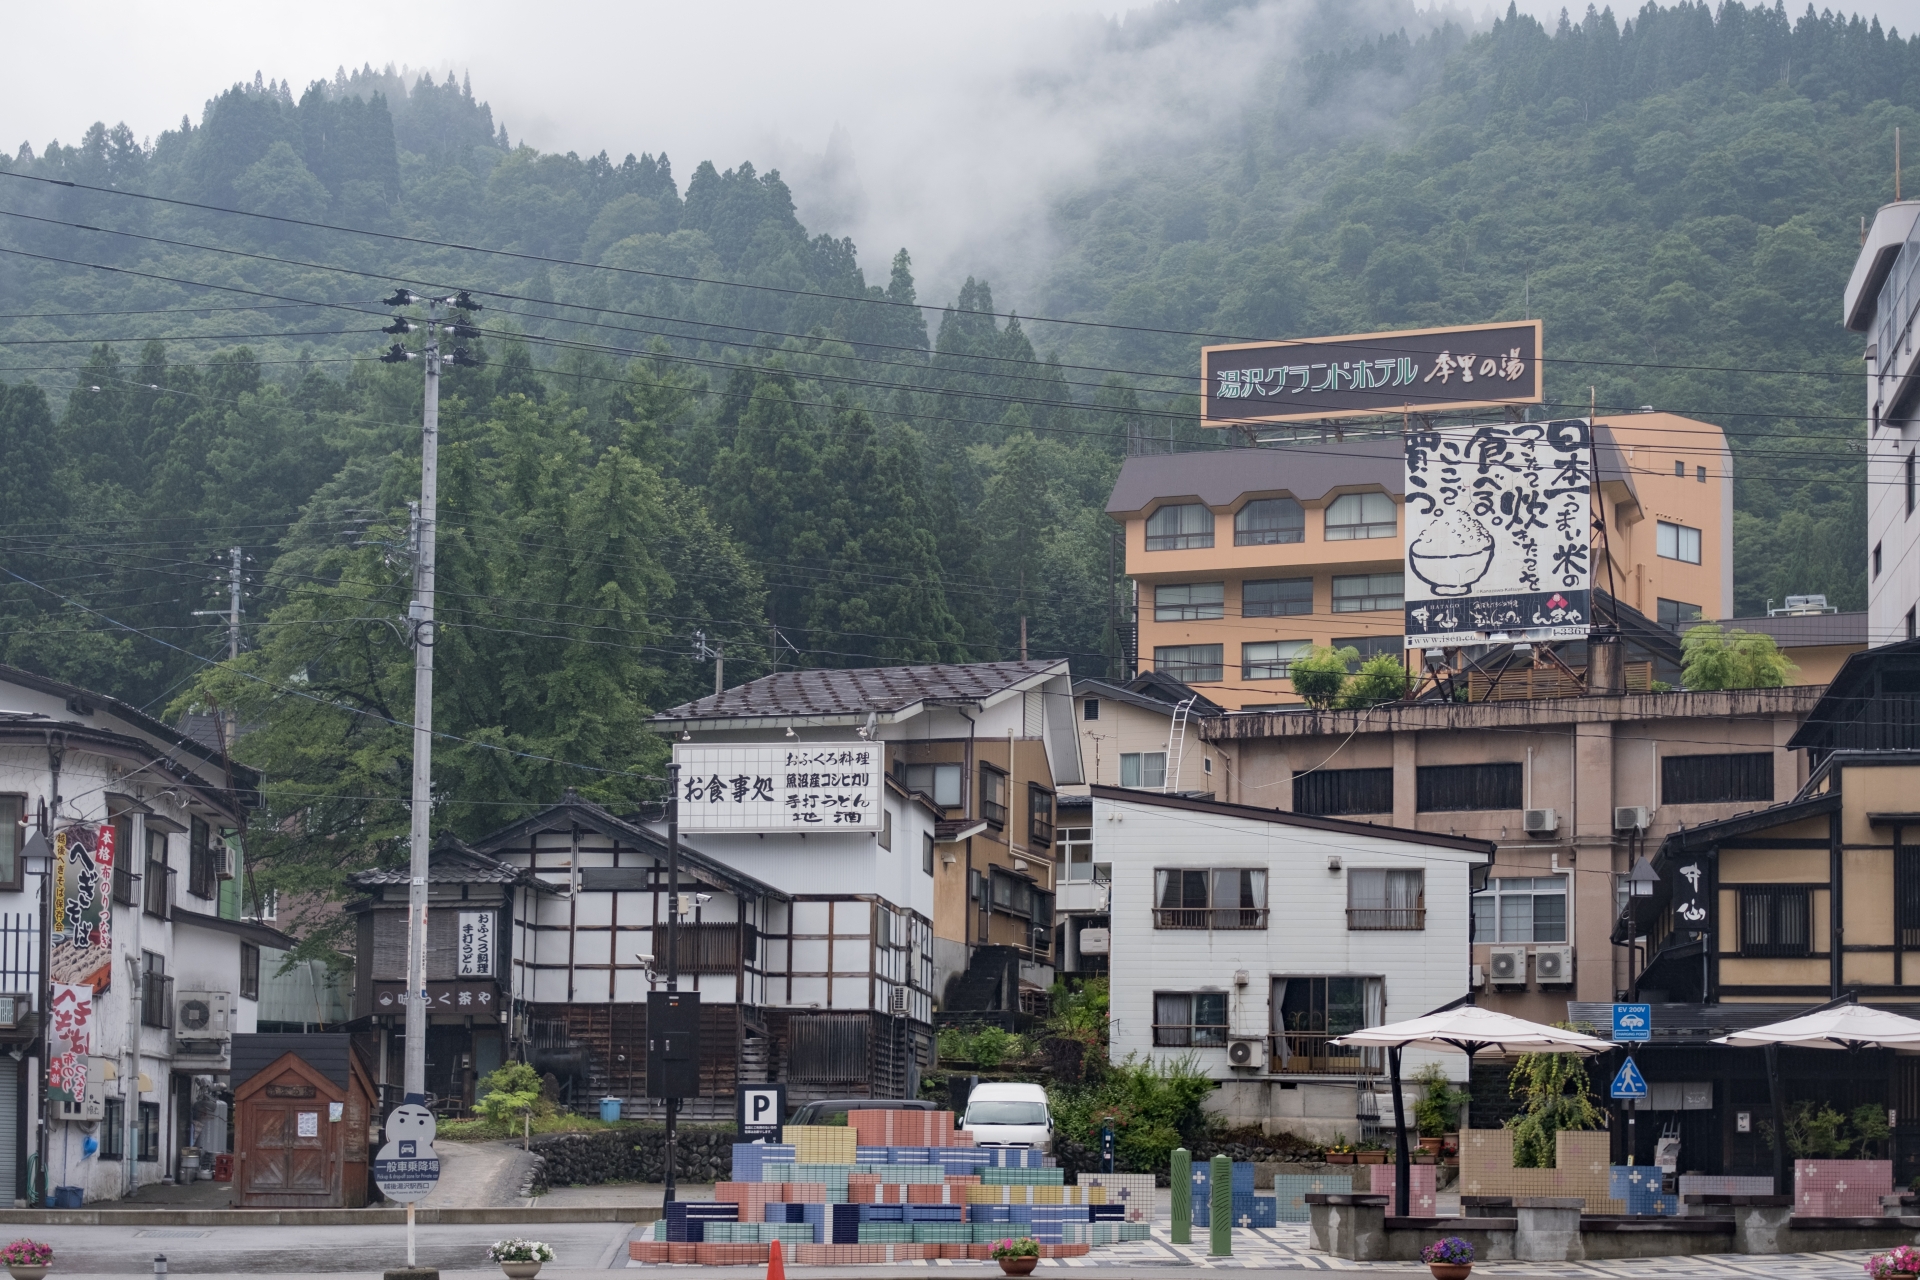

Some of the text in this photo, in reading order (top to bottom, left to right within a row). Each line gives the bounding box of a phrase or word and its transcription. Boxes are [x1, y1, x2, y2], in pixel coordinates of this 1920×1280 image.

[1216, 347, 1526, 399] 湯沢グランドホテル 季里の湯
[1439, 441, 1466, 506] ここで
[1464, 426, 1523, 526] 食べる。
[1500, 424, 1549, 592] つきたて炊きたてを
[1543, 419, 1590, 588] 日本一うまい米の
[1532, 604, 1582, 625] んまや
[785, 750, 870, 766] おふくろ料理
[786, 772, 869, 788] 魚沼産コシヒカリ
[684, 773, 775, 804] お食事処
[785, 793, 870, 808] 手打うどん
[98, 829, 113, 861] 本格
[66, 842, 98, 948] へぎそば
[98, 865, 113, 950] 布のりつなぎ
[462, 923, 474, 974] 手打うどん
[477, 913, 489, 974] おふくろ料理
[753, 1095, 770, 1122] P
[376, 1160, 439, 1173] 一般車乗降場
